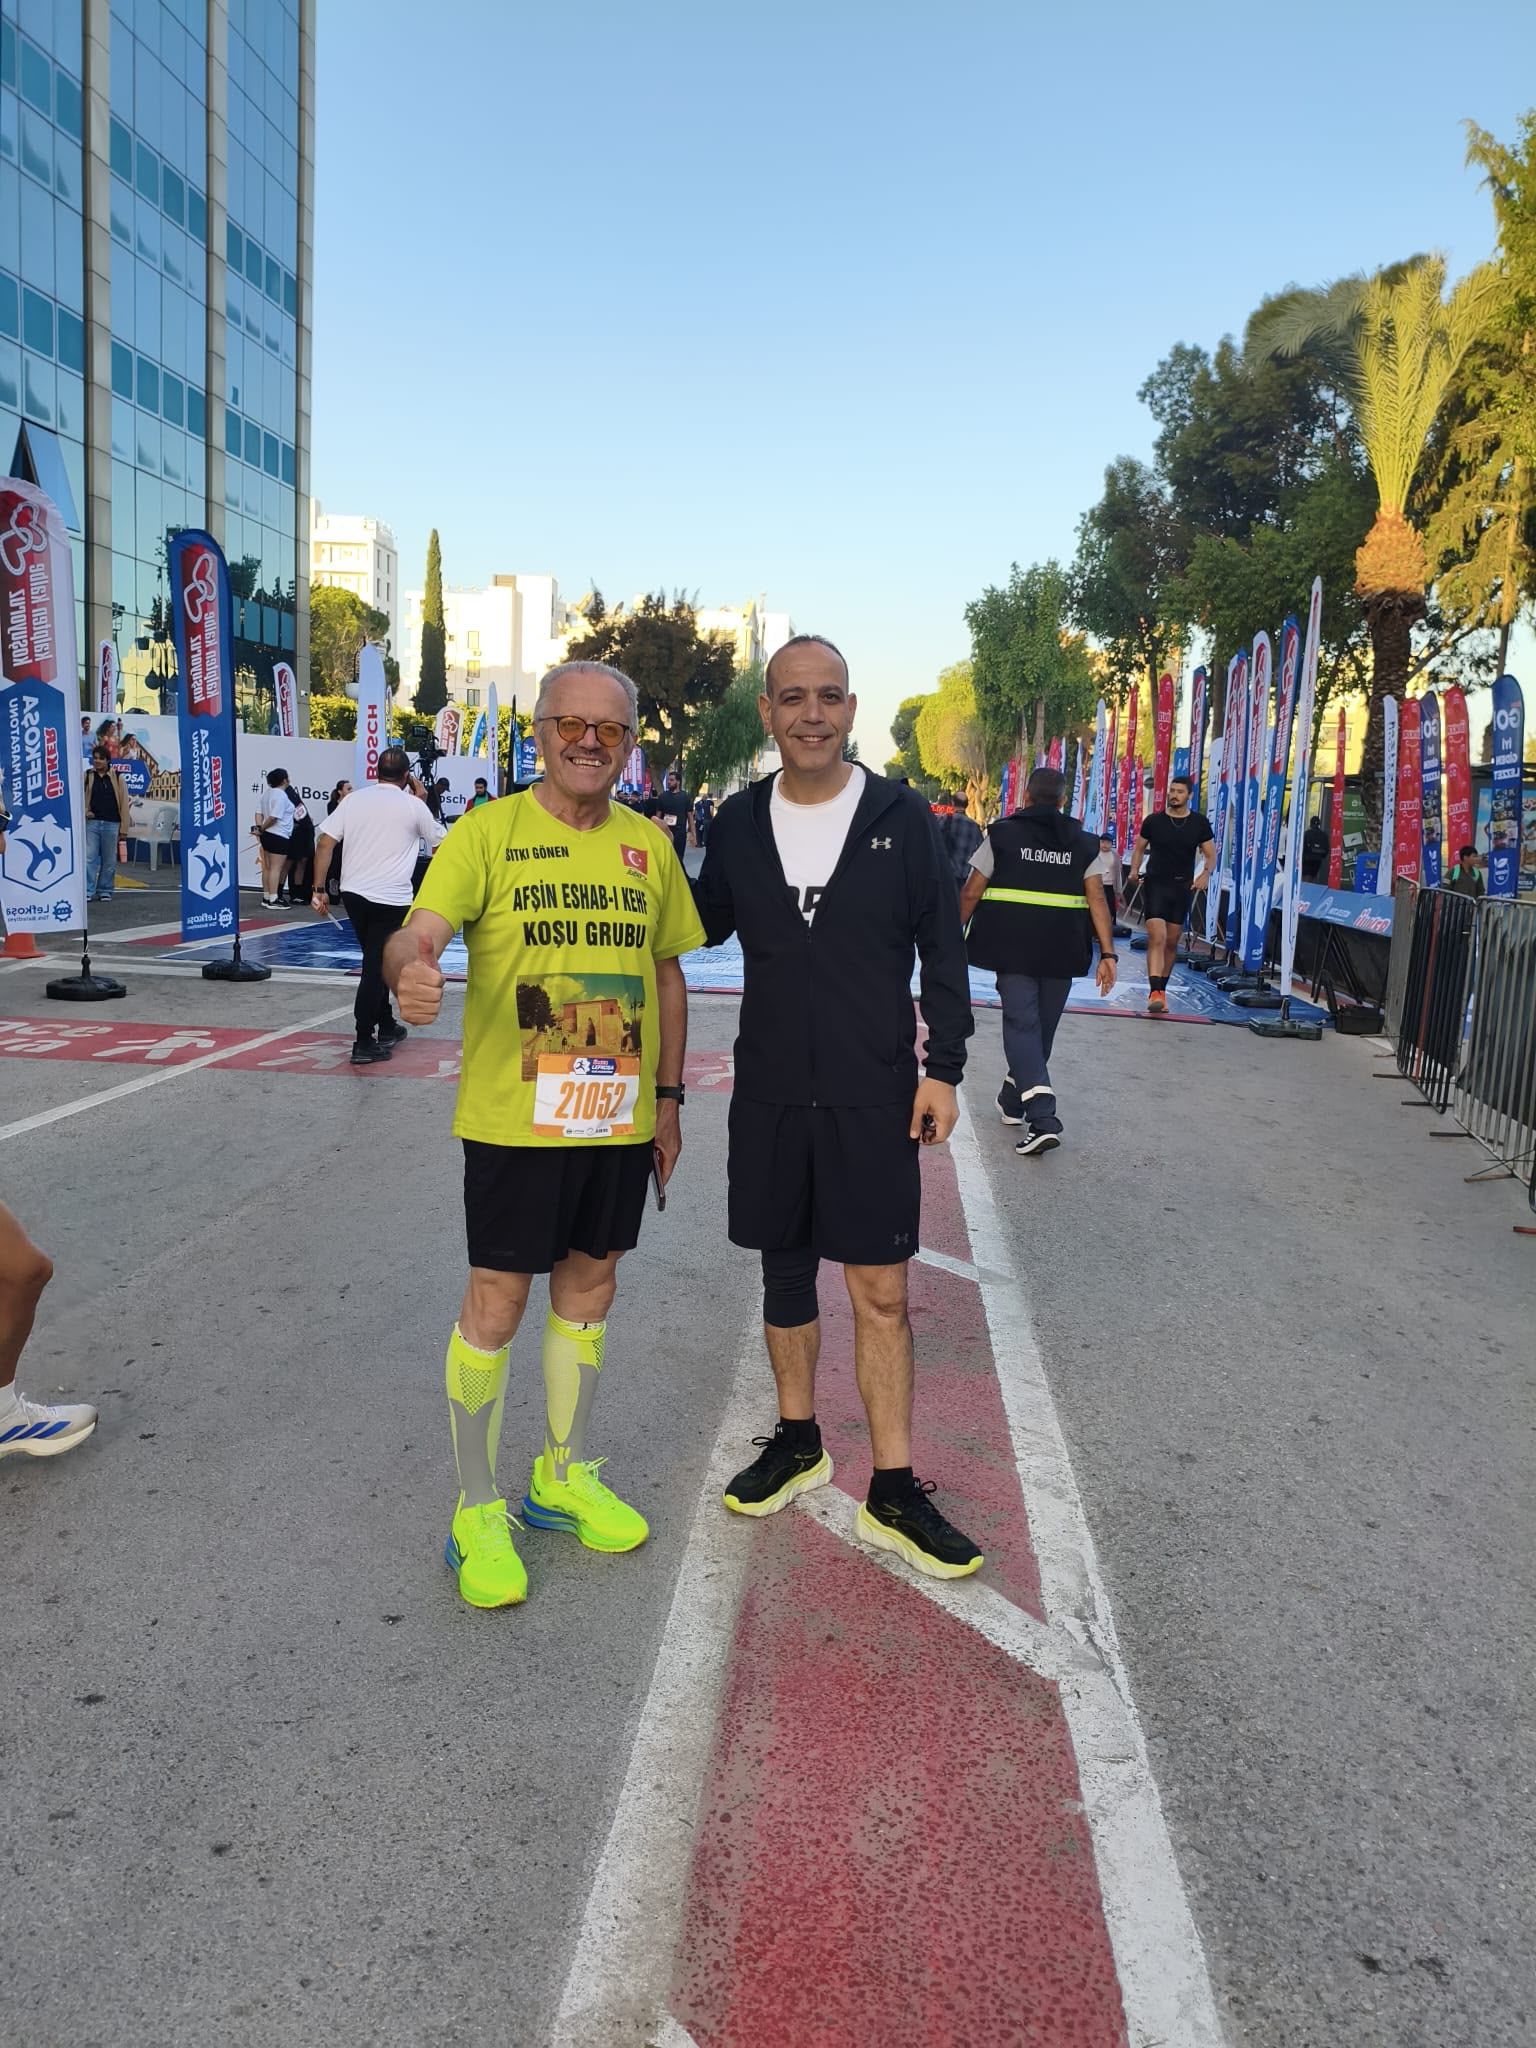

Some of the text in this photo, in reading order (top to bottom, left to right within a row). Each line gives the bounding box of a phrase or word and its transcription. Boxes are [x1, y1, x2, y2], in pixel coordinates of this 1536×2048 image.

[505, 845, 569, 862] SITKI GÖNEN
[1020, 847, 1035, 861] YOL
[513, 879, 648, 915] AFŞİN ESHAB-I KEHF
[523, 920, 646, 949] KOŞU GRUBU
[554, 1081, 627, 1120] 21052
